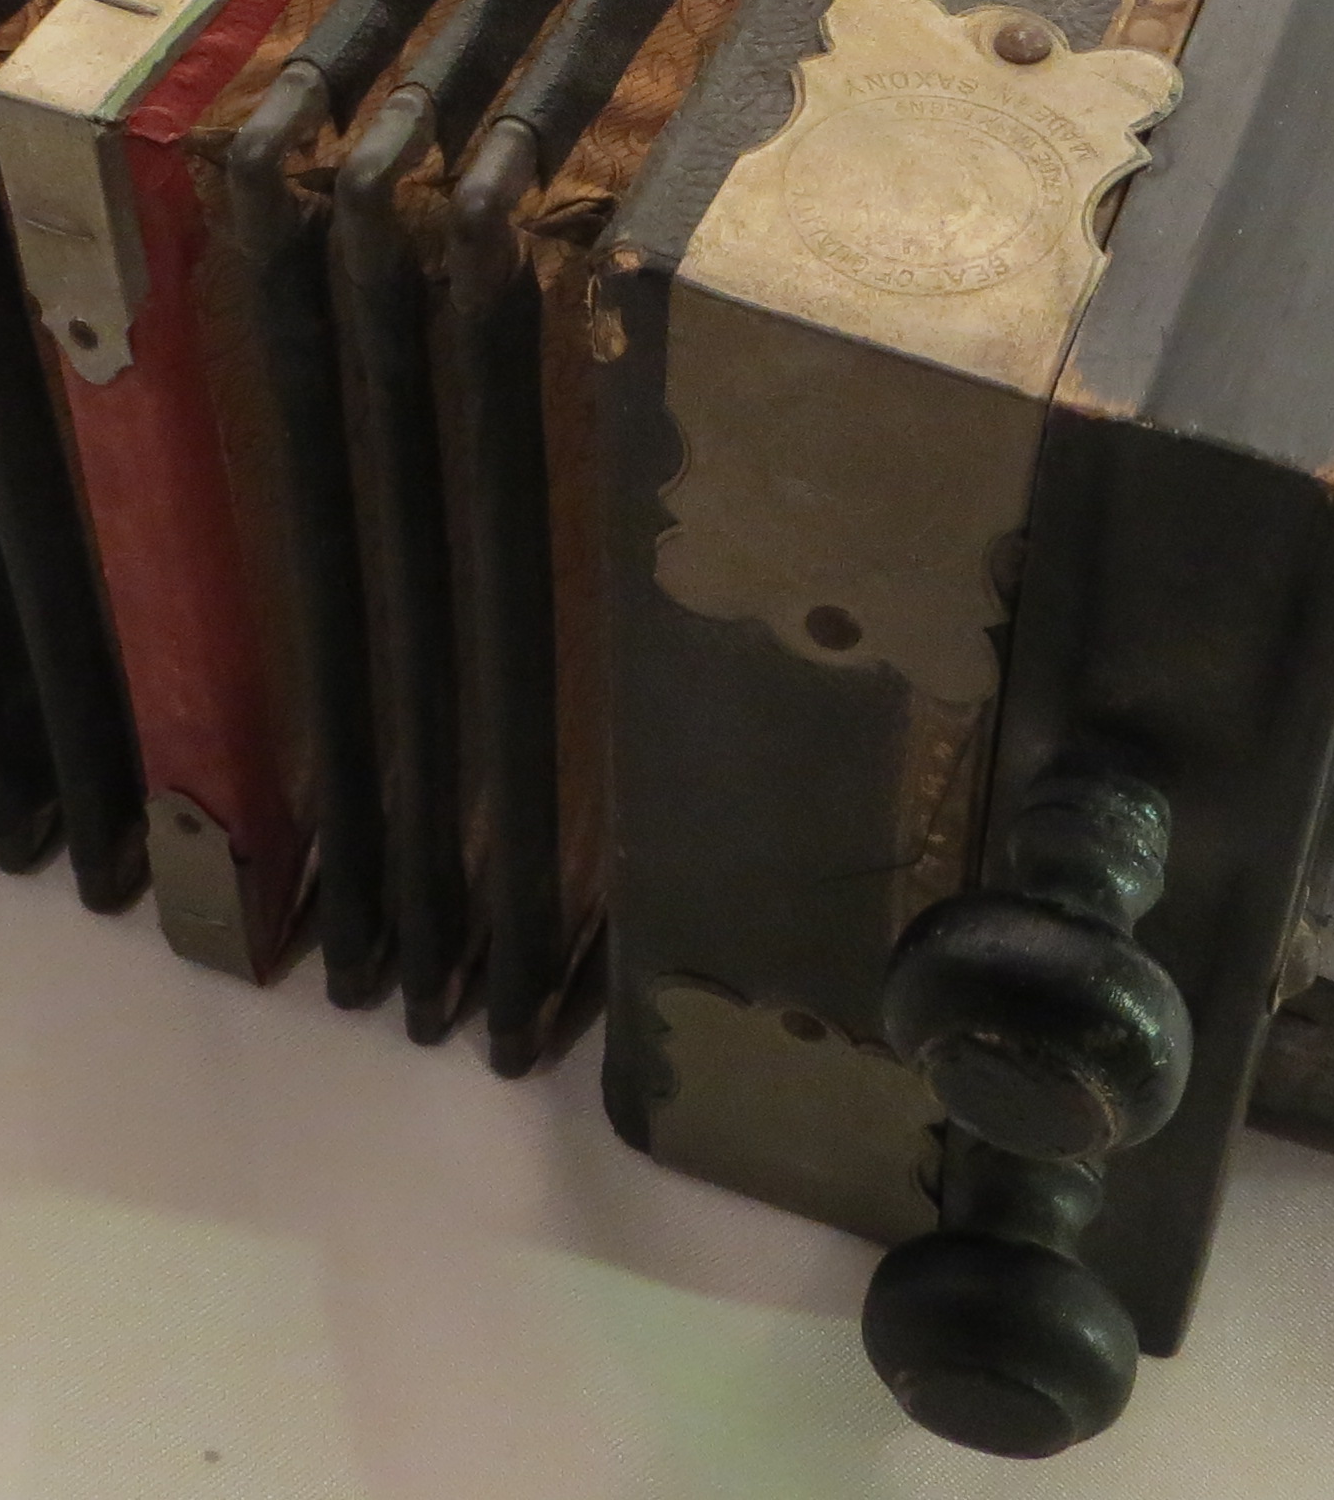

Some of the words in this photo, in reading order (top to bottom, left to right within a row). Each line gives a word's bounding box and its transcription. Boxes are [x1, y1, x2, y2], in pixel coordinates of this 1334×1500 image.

[845, 69, 980, 99] SAXONY
[1034, 104, 1099, 165] MADE
[874, 268, 915, 290] OF
